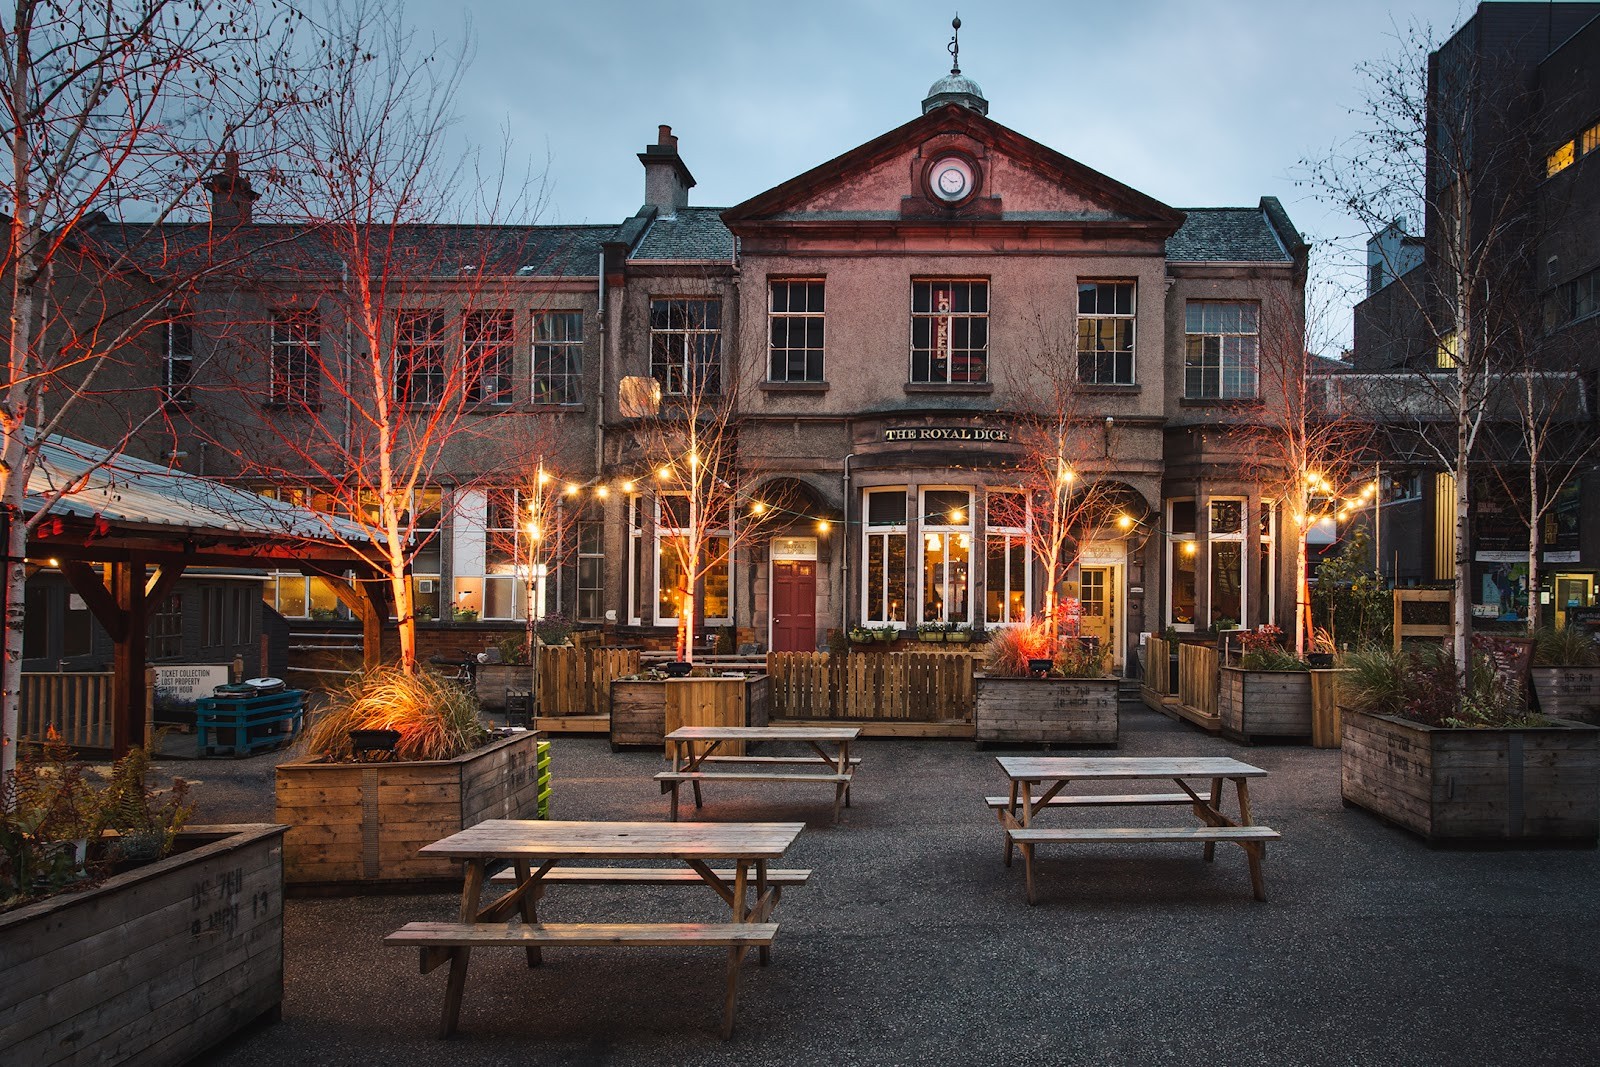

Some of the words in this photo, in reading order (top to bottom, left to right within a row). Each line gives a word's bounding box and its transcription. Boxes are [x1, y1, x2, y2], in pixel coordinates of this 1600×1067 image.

[937, 289, 949, 360] LOCKED
[885, 429, 916, 440] THE
[919, 428, 971, 439] ROYAL
[974, 429, 1009, 441] DICK
[161, 669, 178, 677] TICKET
[180, 669, 210, 677] COLLECTION
